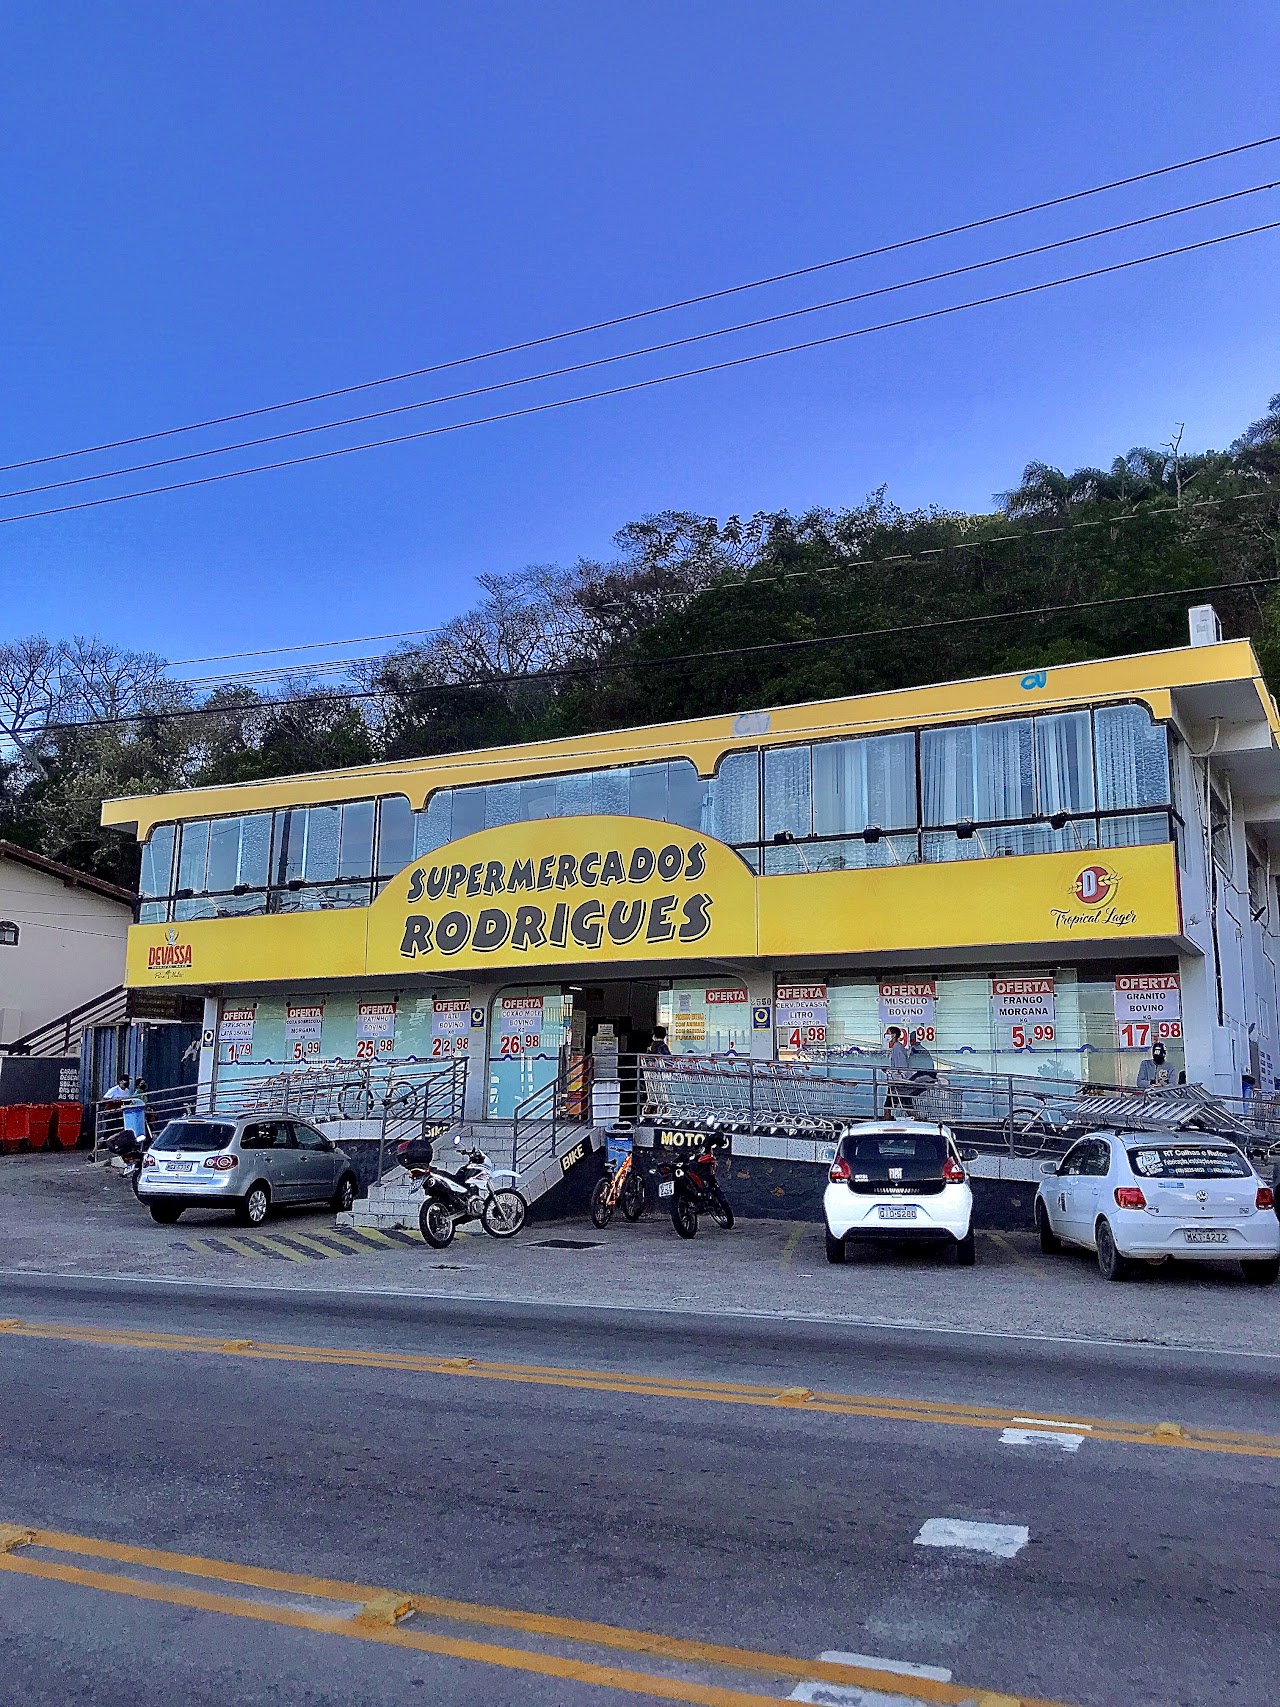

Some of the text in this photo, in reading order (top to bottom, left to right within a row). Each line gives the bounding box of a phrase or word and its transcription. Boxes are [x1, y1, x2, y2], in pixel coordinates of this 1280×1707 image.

[407, 842, 707, 903] SUPERMERCADOS
[1050, 907, 1137, 929] Tropical Lager
[400, 893, 714, 959] RODRIGUES
[148, 944, 192, 966] DEVASSA
[995, 981, 1051, 994] OFERTA
[1119, 976, 1178, 990] OFERTA
[707, 991, 745, 1001] OFERTA
[776, 988, 824, 1000] OFERTA
[882, 985, 932, 997] OFERTA
[1126, 991, 1166, 1001] GRANITO
[504, 999, 541, 1009] OFERTA
[884, 998, 928, 1006] MUSCULO
[1003, 995, 1043, 1005] FRANGO
[289, 1008, 321, 1017] OFERTA
[360, 1004, 394, 1015] OFERTA
[435, 1001, 470, 1012] OFERTA
[889, 1008, 923, 1017] BOVINO
[999, 1007, 1049, 1017] MORGANA
[1129, 1004, 1164, 1012] BOVINO
[223, 1011, 253, 1020] OFERTA
[789, 1011, 813, 1019] LITRO
[439, 1021, 464, 1029] BOVINO
[789, 1027, 825, 1049] 4,98
[1012, 1025, 1054, 1048] 5,99
[1121, 1023, 1181, 1047] 17,98
[293, 1041, 320, 1059] 5,99
[356, 1040, 393, 1058] 25,98
[432, 1038, 469, 1056] 22,98
[500, 1035, 539, 1054] 26,98
[228, 1043, 251, 1060] 1,79
[562, 1143, 585, 1171] BIKE
[888, 1167, 903, 1180] FIAT
